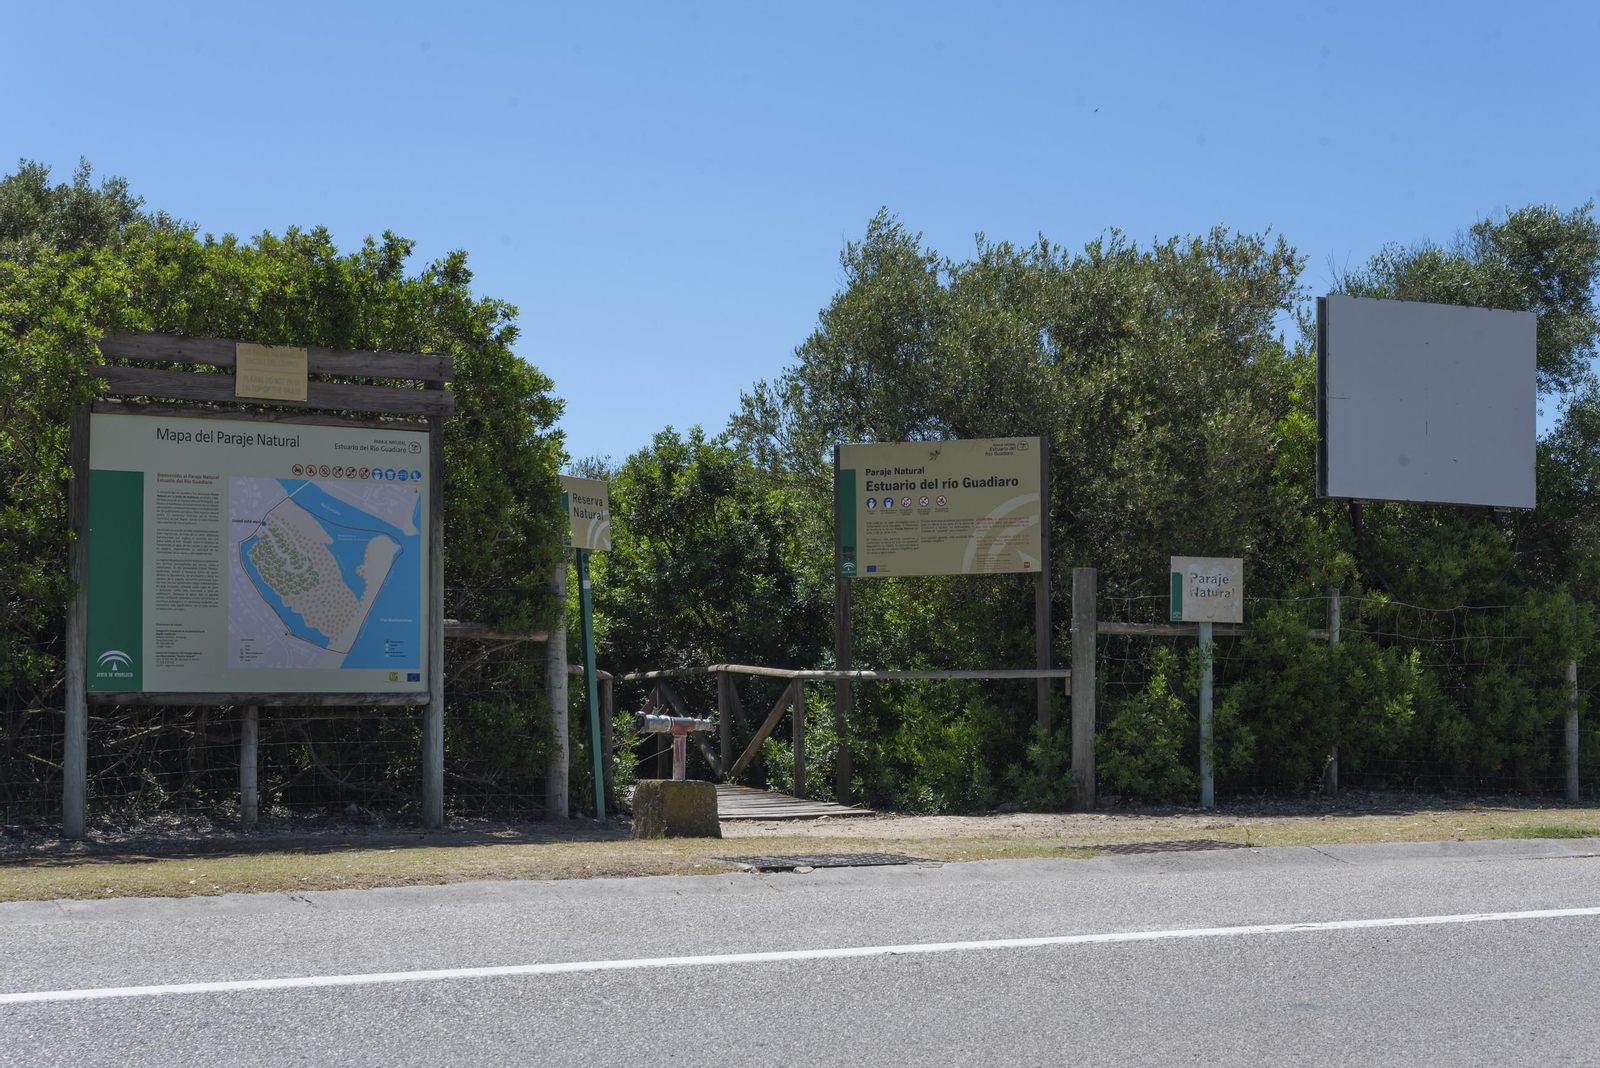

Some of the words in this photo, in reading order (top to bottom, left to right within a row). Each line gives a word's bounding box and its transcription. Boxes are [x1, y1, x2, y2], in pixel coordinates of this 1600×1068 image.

[243, 375, 264, 384] PLEASE
[156, 428, 192, 444] Mapa
[195, 429, 213, 443] del
[217, 431, 254, 448] Paraje
[257, 434, 300, 448] Natural
[866, 468, 892, 477] Paraje
[894, 466, 925, 475] Natural
[866, 480, 916, 491] Estuario
[920, 478, 938, 490] del
[942, 478, 958, 489] río
[962, 476, 1018, 488] Guadiaro
[572, 493, 603, 506] Reserva
[573, 507, 603, 520] Natural
[1190, 572, 1229, 586] Paraje
[1190, 586, 1235, 598] Natural
